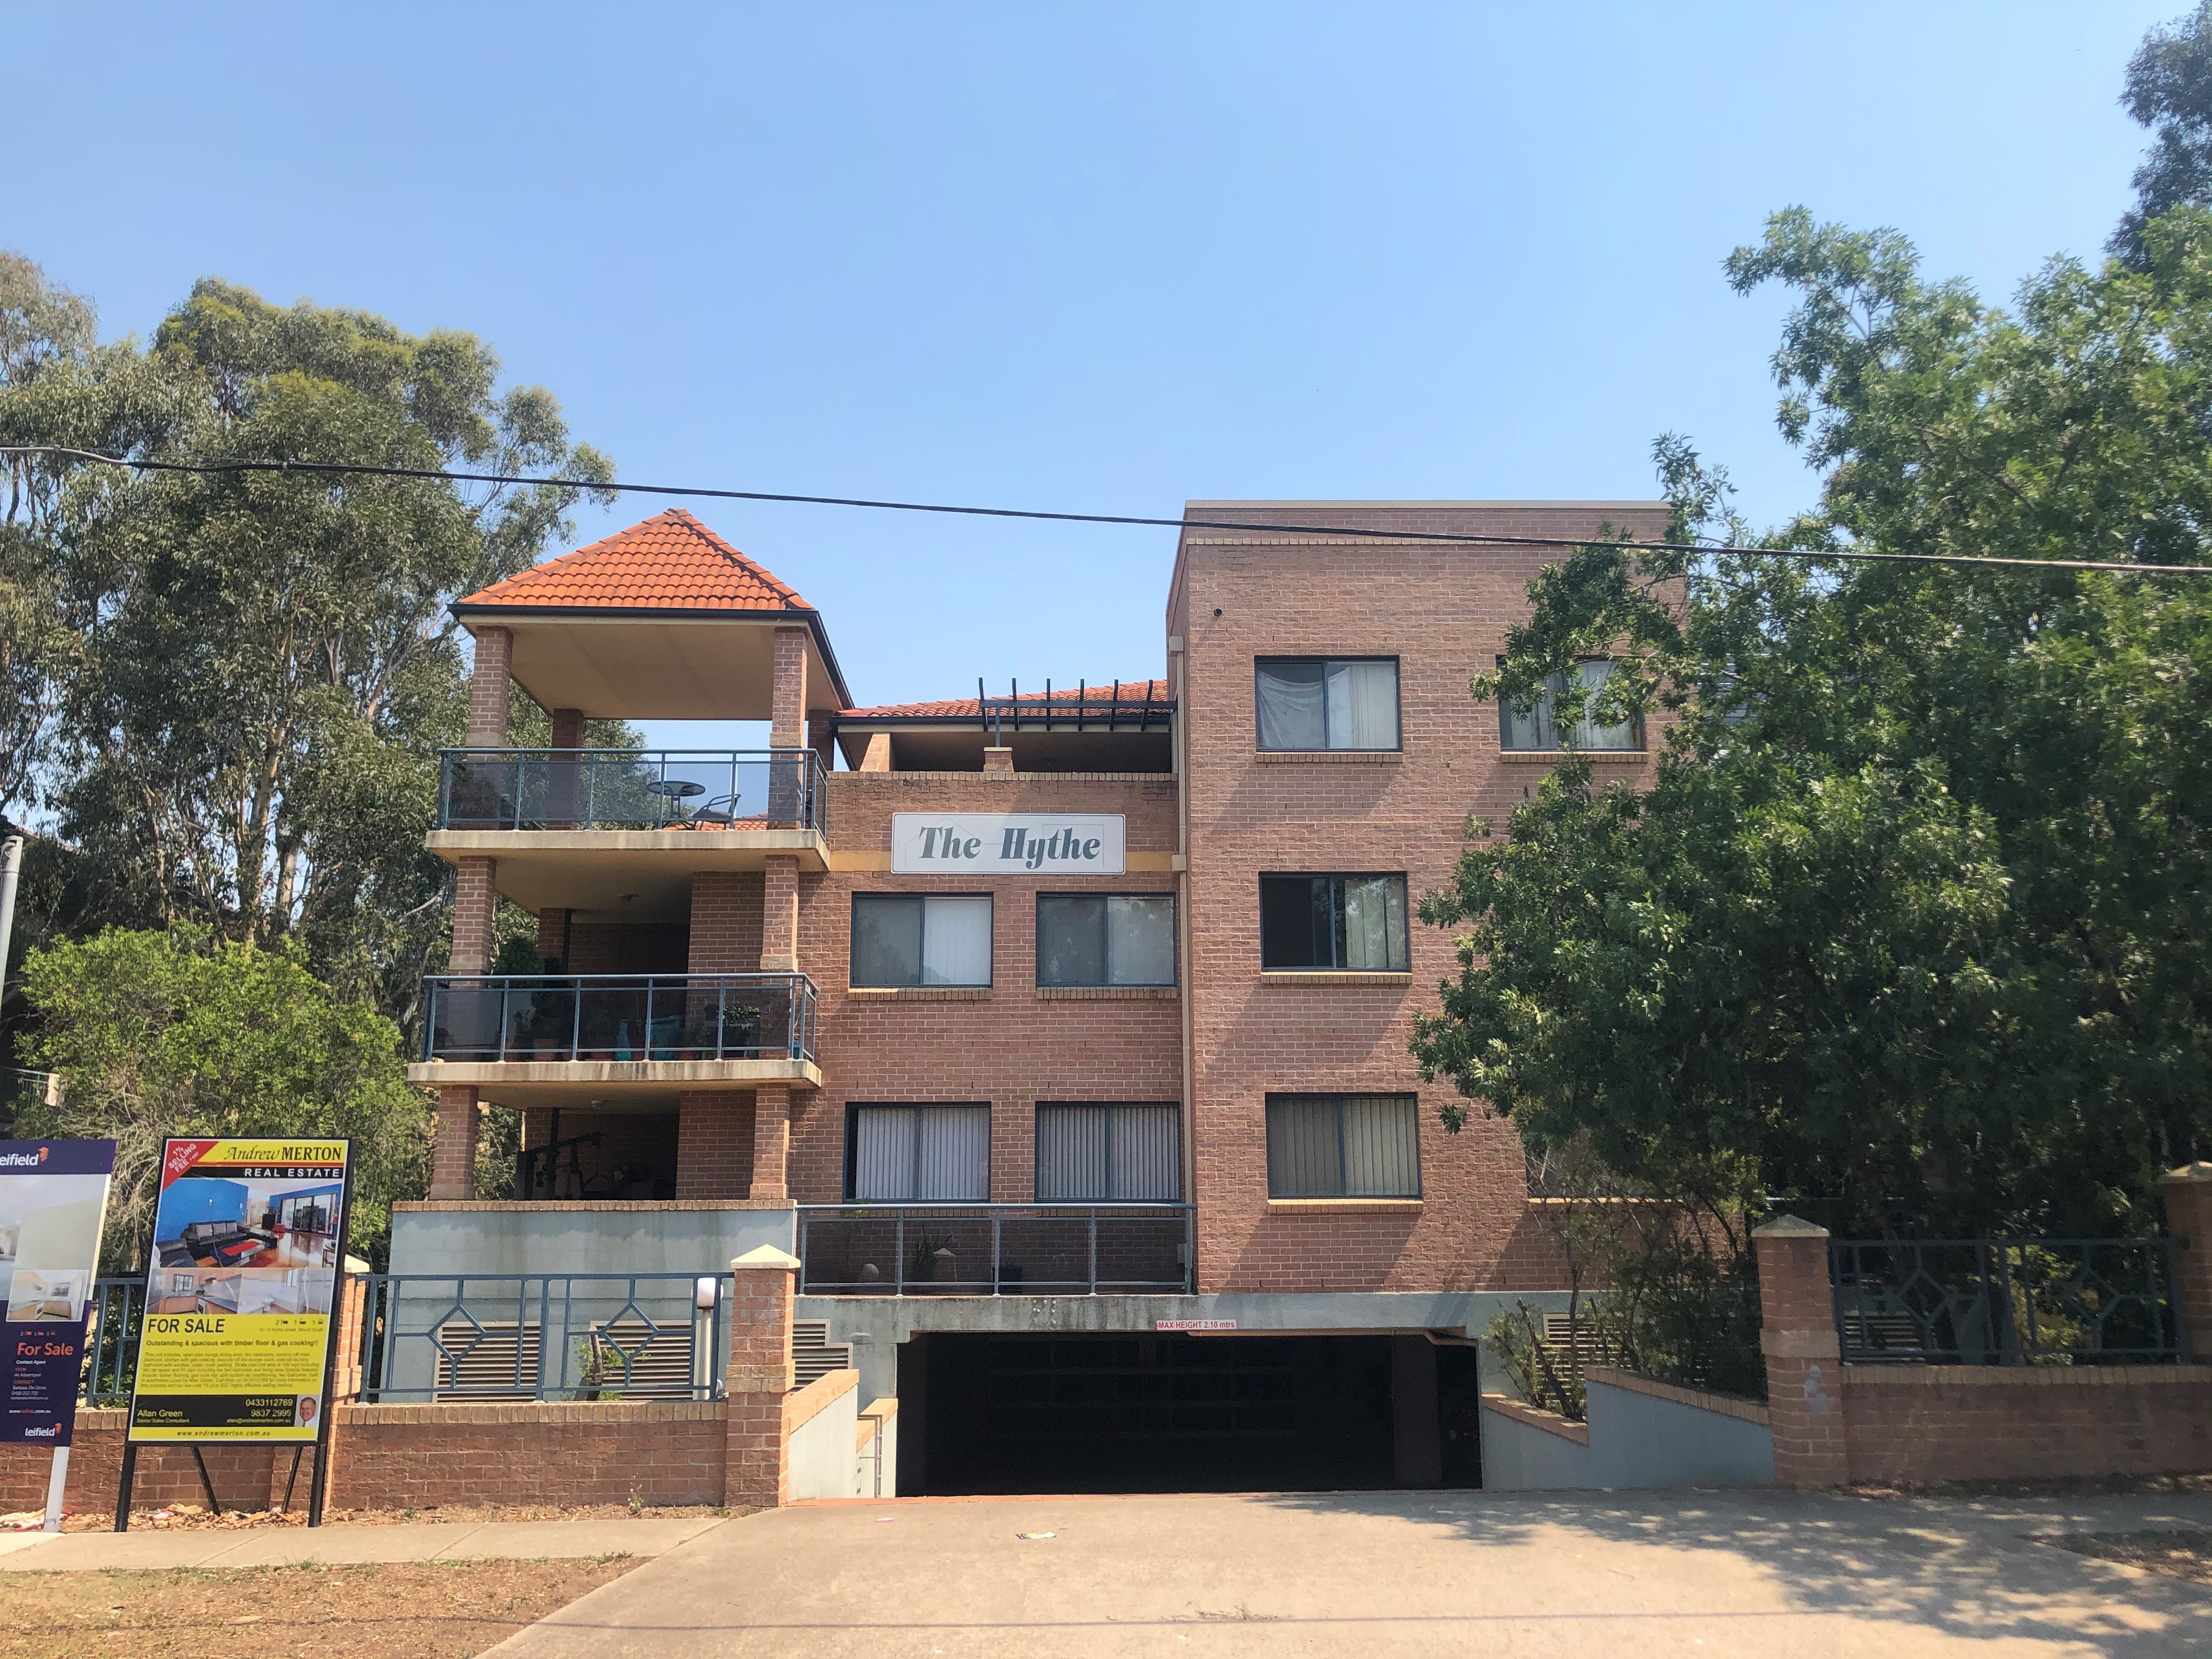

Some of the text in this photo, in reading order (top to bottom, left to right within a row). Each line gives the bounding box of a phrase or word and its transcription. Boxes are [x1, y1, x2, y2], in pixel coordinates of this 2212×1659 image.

[918, 826, 1101, 870] The Hythe
[0, 1153, 39, 1166] eifield
[168, 1143, 196, 1169] SELLING
[224, 1145, 342, 1161] Andrew MERTON
[174, 1159, 189, 1172] FEE
[244, 1168, 340, 1177] REAL ESTATE
[148, 1318, 225, 1333] FOR SALE
[17, 1342, 74, 1356] For Sale
[245, 1398, 294, 1407] 0433112769
[159, 1409, 183, 1417] Green
[25, 1427, 55, 1436] leifield
